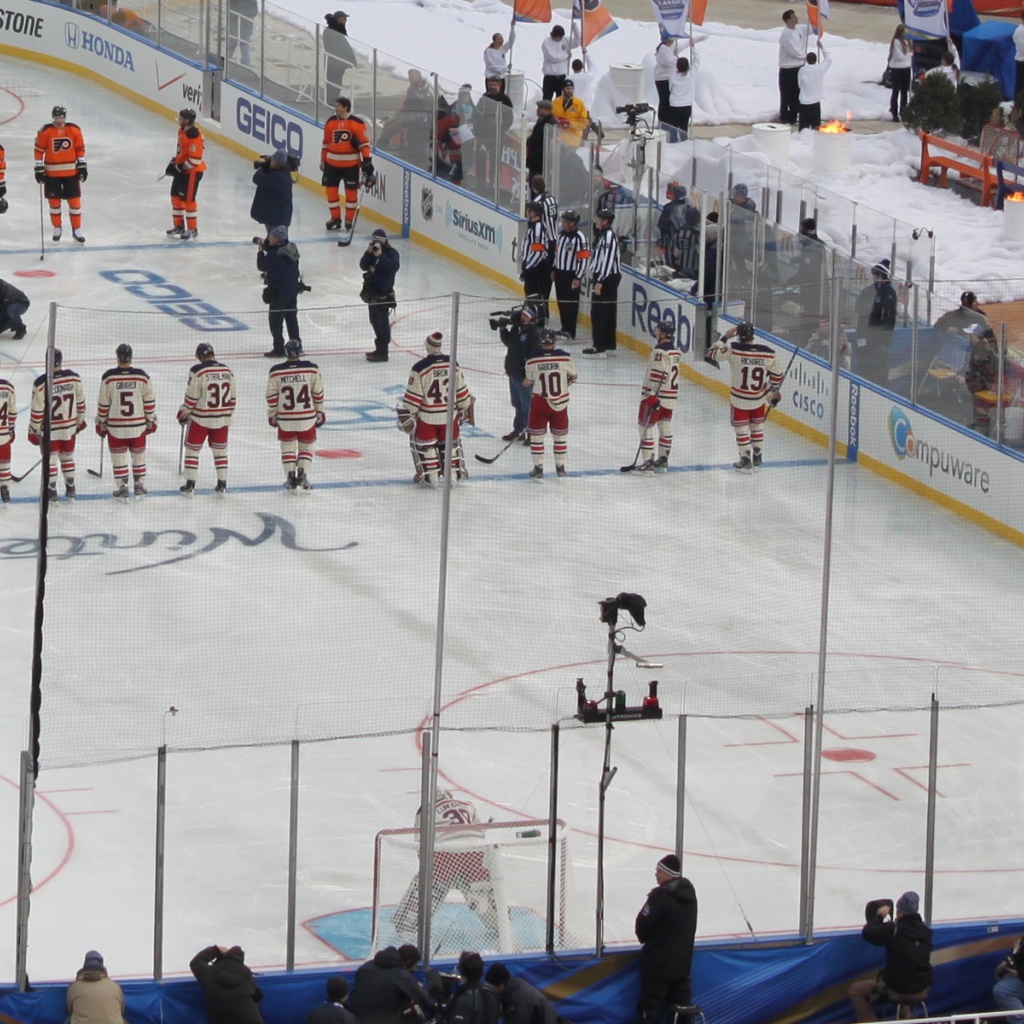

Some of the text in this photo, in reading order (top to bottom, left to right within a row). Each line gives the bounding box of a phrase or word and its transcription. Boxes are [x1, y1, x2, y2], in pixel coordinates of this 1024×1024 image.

[80, 31, 136, 73] HONDA
[236, 96, 304, 160] GEICO
[740, 357, 766, 367] RICHARDS
[115, 381, 138, 391] GIRARDI
[279, 374, 307, 384] MITCHELL
[538, 372, 562, 398] 10
[740, 366, 765, 391] 19
[50, 393, 75, 421] 27
[119, 391, 135, 417] 5
[206, 382, 232, 409] 32
[279, 384, 311, 411] 34
[792, 390, 824, 420] CISCO
[894, 418, 990, 493] Compuware
